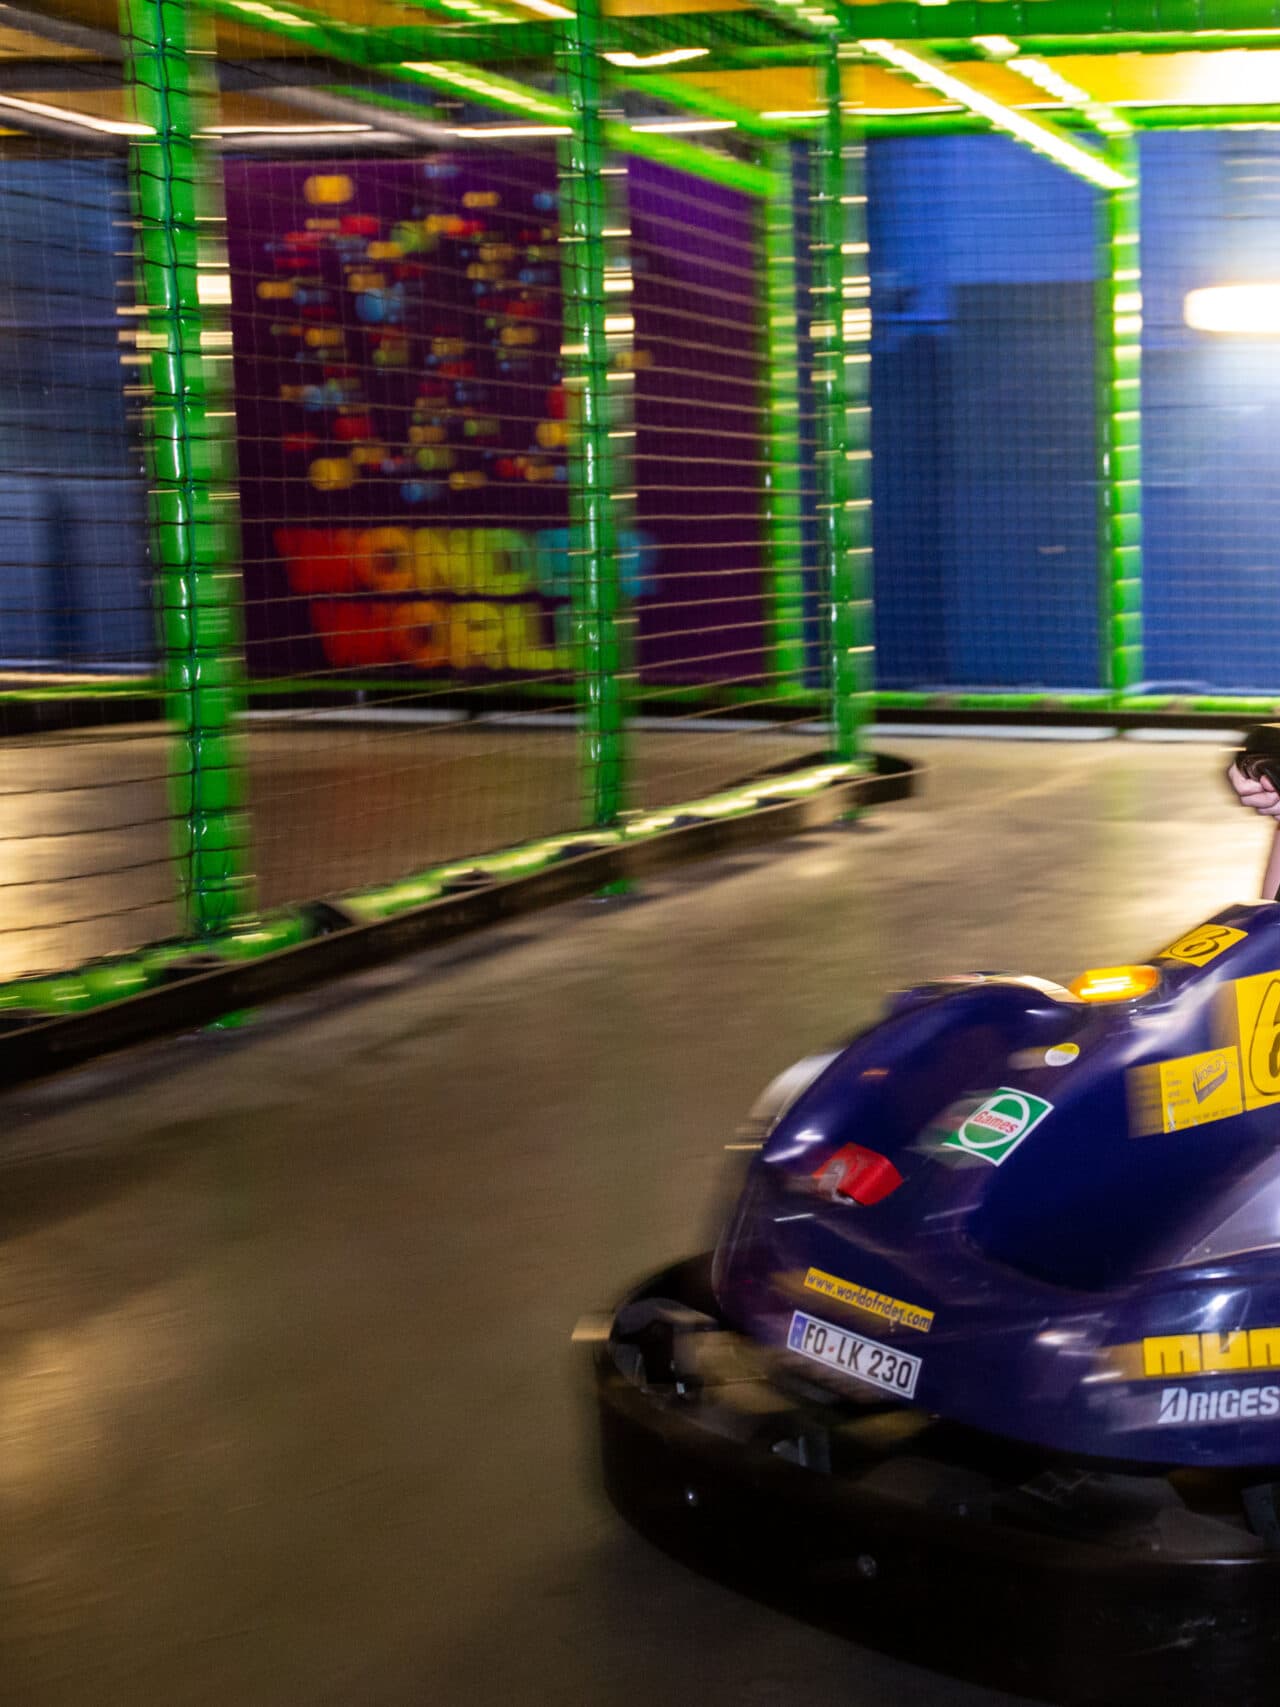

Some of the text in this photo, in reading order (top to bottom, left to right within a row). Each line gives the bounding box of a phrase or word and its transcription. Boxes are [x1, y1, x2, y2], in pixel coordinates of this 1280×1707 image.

[1170, 928, 1231, 957] 6
[973, 1110, 1019, 1133] Games
[867, 1350, 913, 1389] 230
